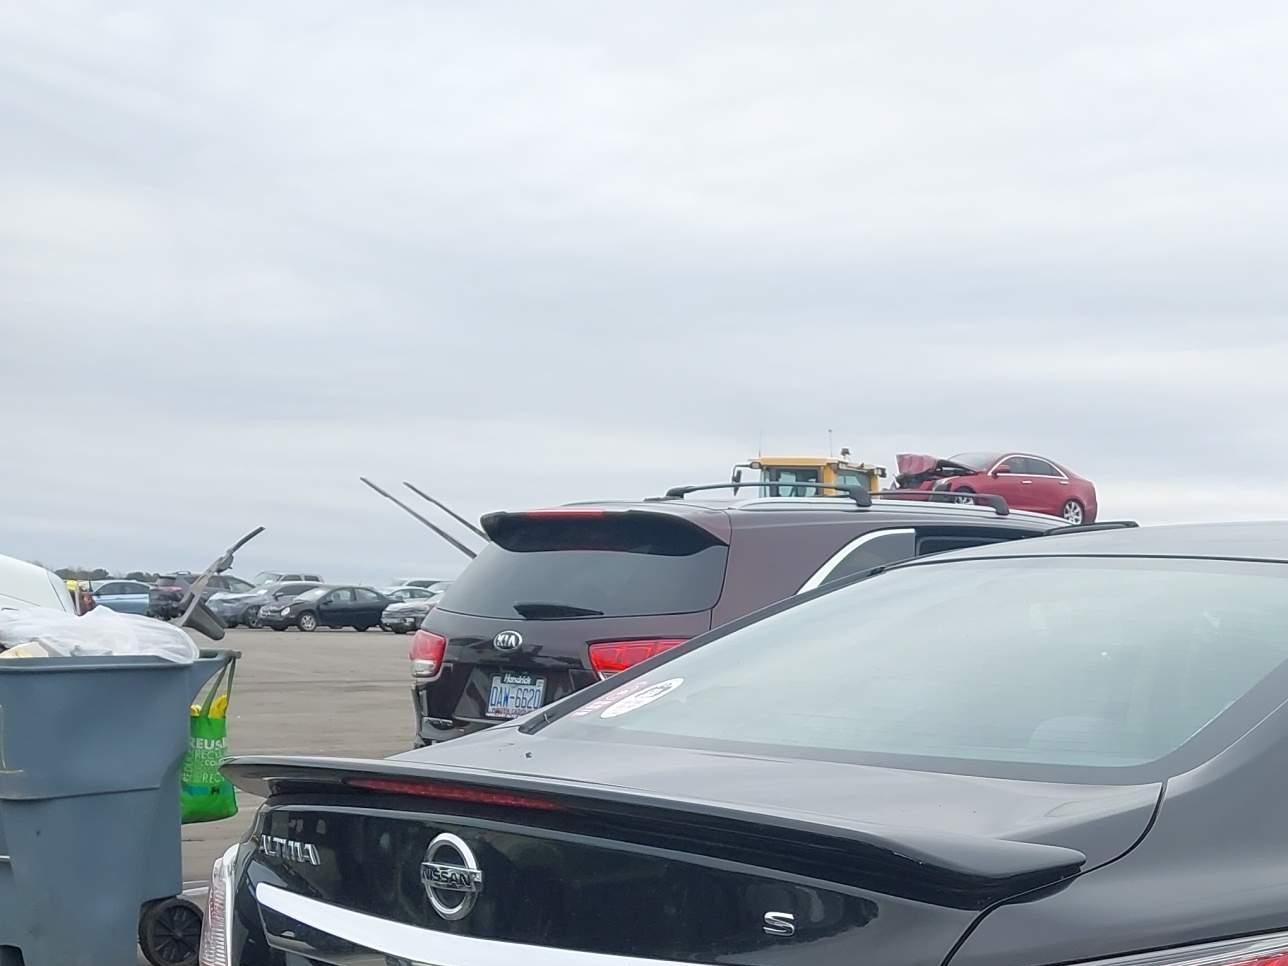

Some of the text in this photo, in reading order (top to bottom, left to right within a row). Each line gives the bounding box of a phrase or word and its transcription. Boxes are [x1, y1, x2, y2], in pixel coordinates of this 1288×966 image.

[497, 634, 516, 647] KIA
[422, 867, 473, 886] NISSAN
[763, 911, 795, 937] S
